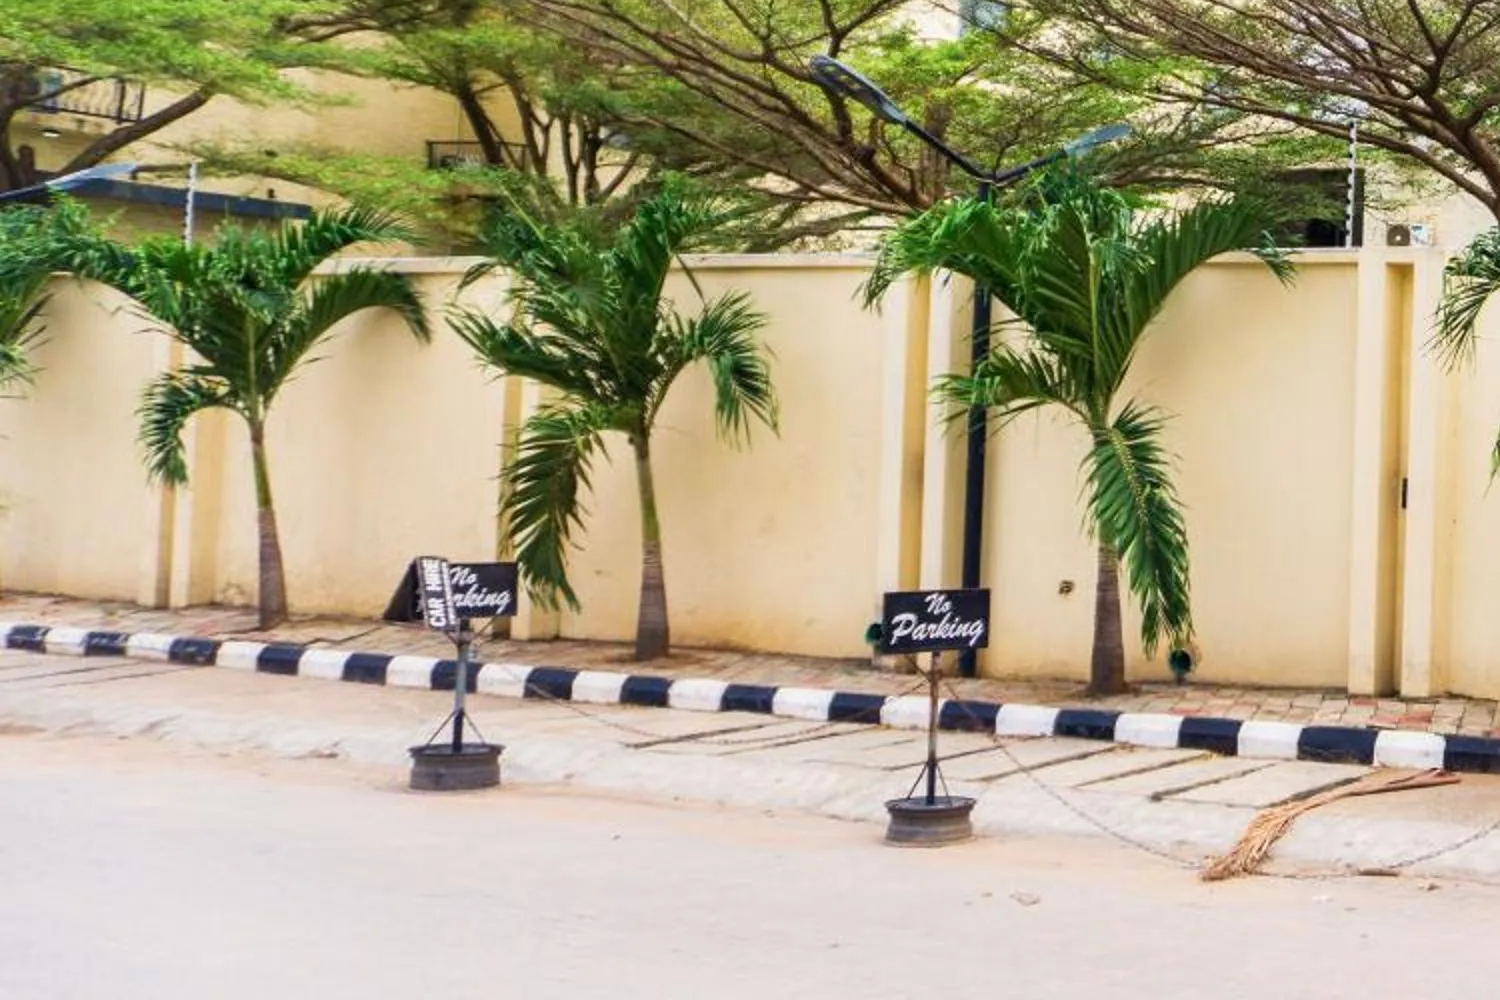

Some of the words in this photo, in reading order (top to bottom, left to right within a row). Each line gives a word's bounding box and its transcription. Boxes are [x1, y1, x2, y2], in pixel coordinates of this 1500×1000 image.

[450, 566, 477, 586] No
[416, 584, 510, 614] rking
[924, 592, 952, 615] No
[889, 611, 984, 647] Parking
